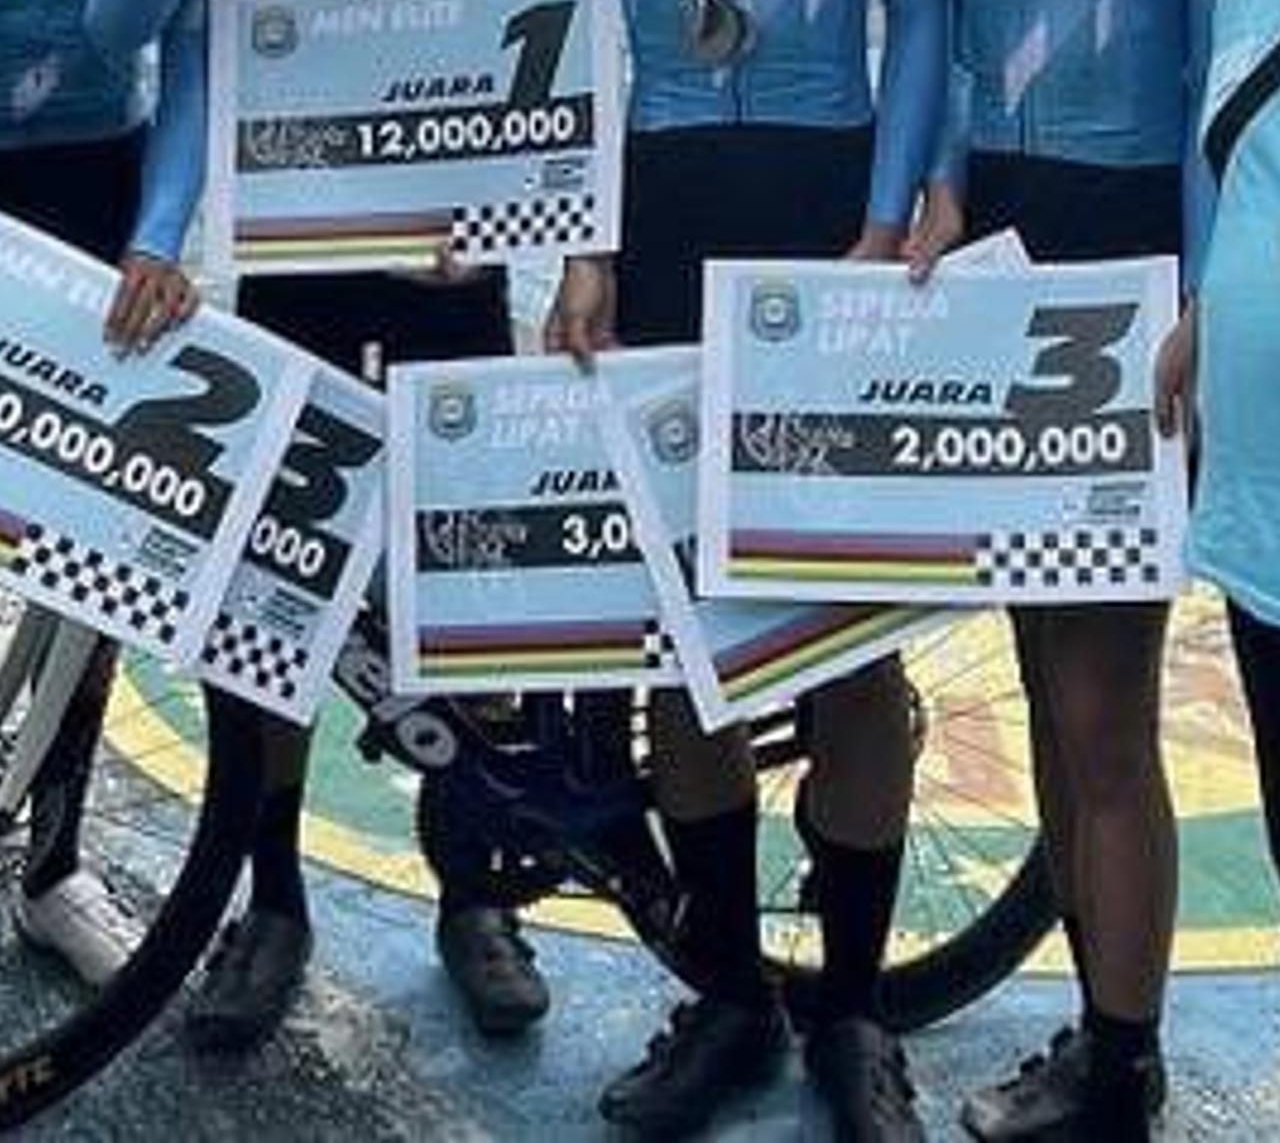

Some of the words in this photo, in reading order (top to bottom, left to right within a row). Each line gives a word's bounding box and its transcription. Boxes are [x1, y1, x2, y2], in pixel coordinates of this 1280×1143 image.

[382, 72, 494, 104] JUARA
[501, 0, 578, 106] 1
[356, 106, 576, 160] 12,000,000
[858, 379, 993, 405] JUARA
[1004, 302, 1141, 422] 3
[113, 345, 264, 471] 2
[891, 422, 1128, 471] 2,000,000
[263, 401, 386, 533] 3
